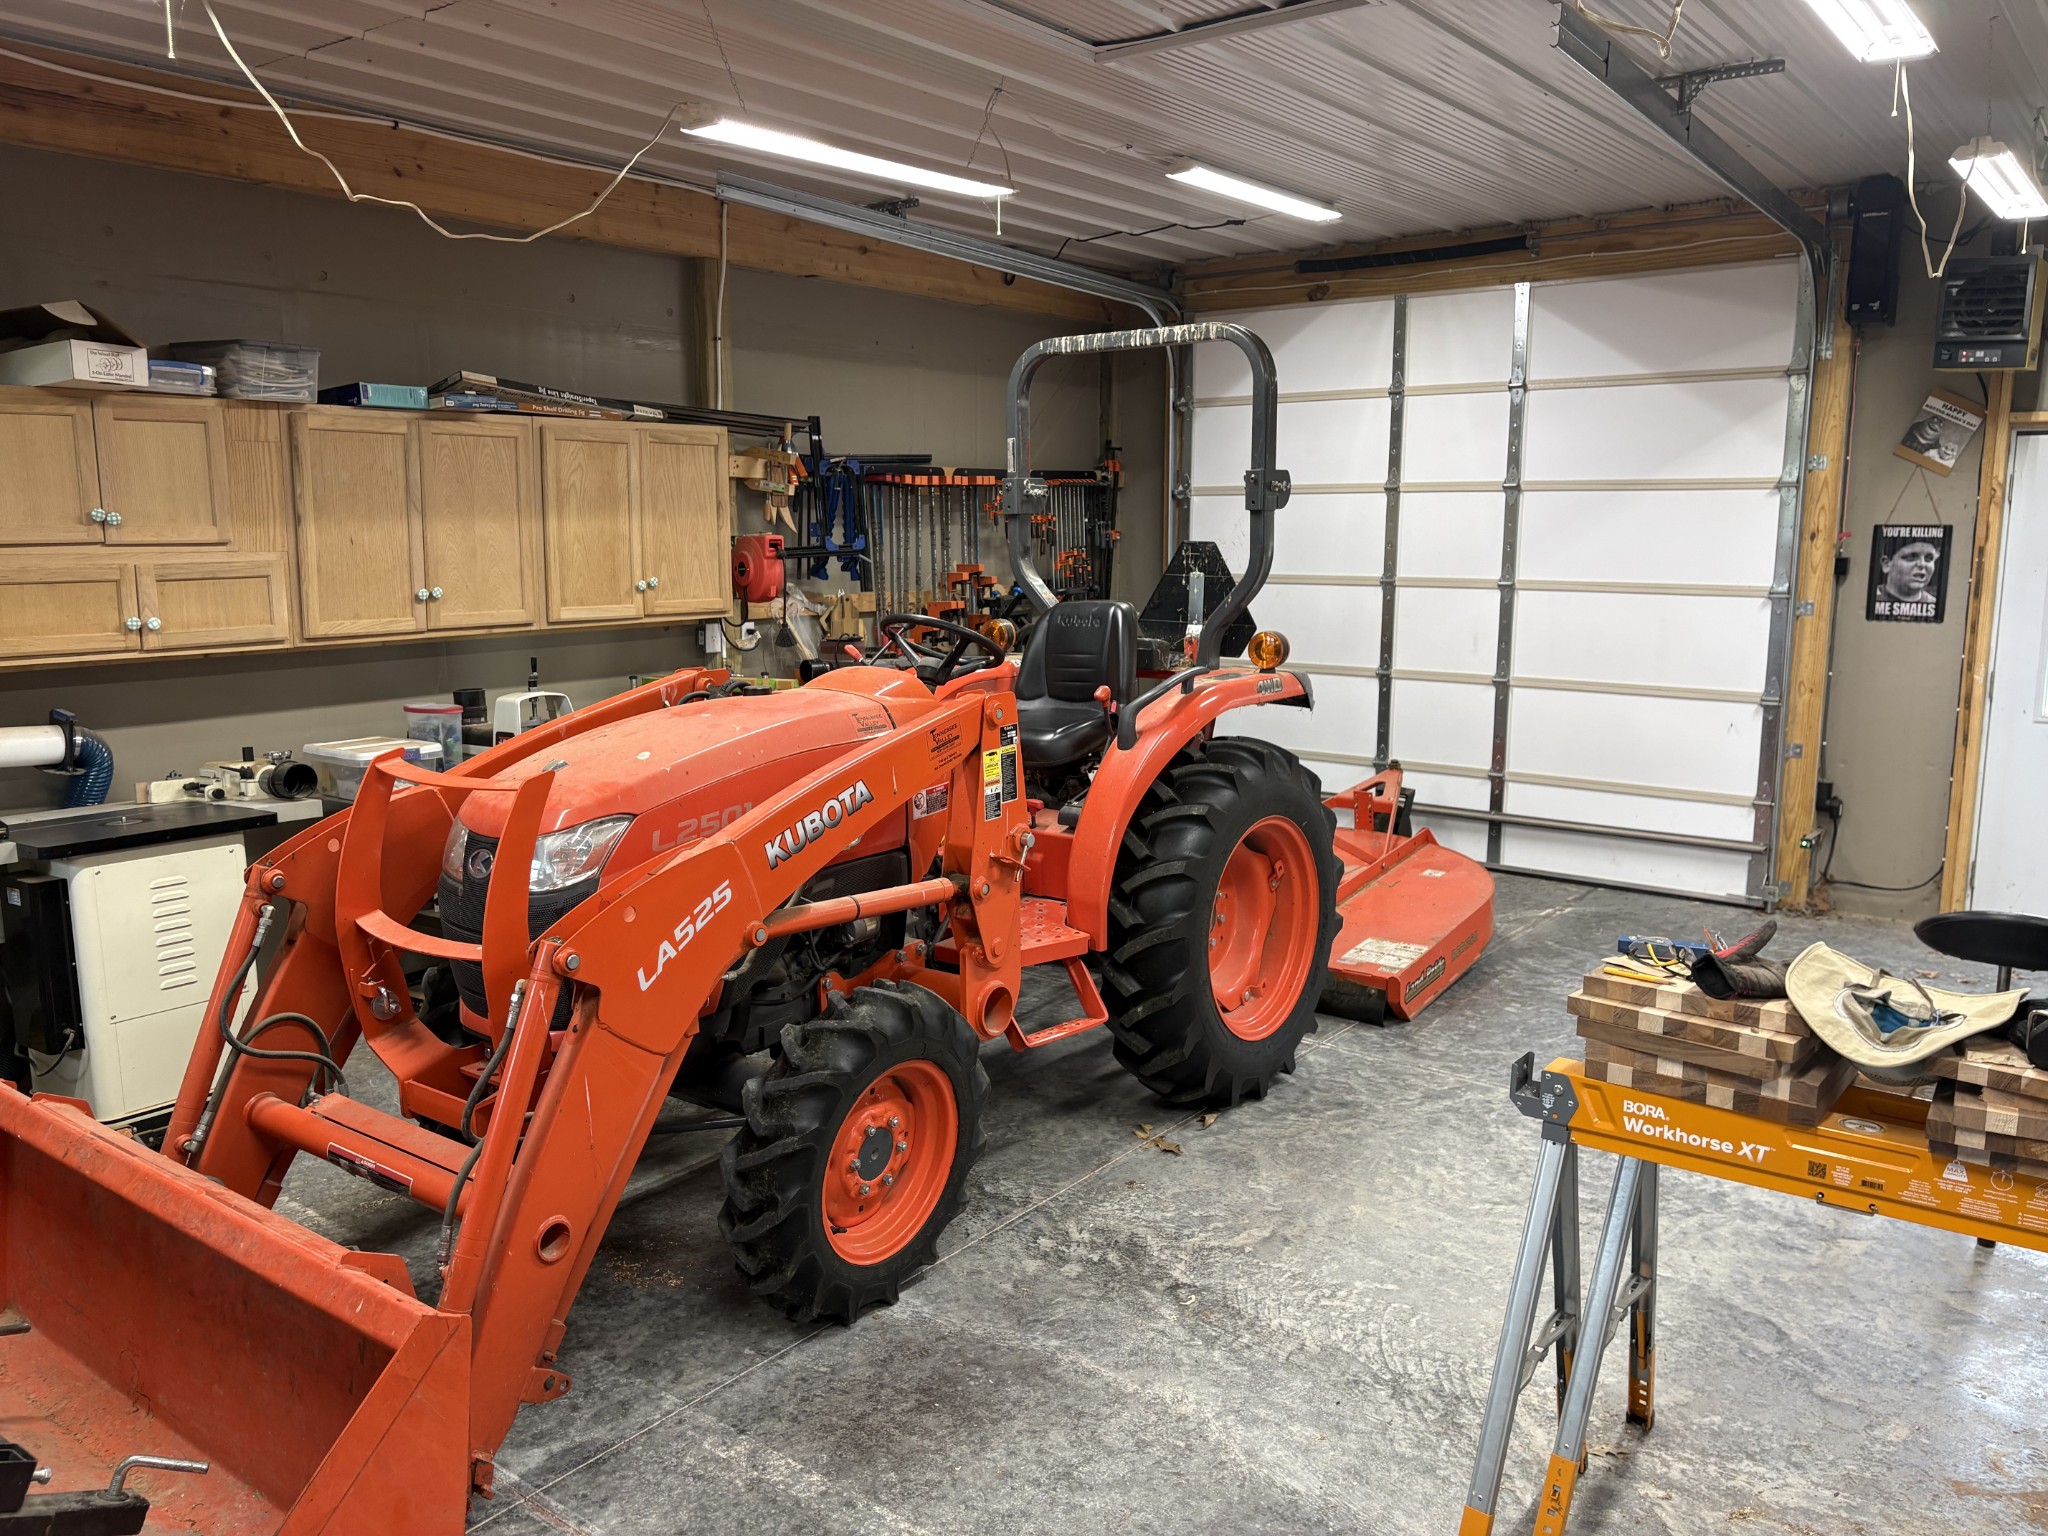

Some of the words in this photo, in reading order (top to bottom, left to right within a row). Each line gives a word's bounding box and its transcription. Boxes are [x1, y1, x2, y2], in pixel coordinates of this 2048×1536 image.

[538, 386, 547, 395] Jig
[547, 389, 560, 398] Line
[557, 407, 577, 415] Drilling
[1941, 403, 1968, 417] HAPPY
[1882, 527, 1910, 537] YOU'RE
[1912, 527, 1944, 538] KILLING
[1875, 602, 1890, 615] ME
[1892, 602, 1936, 616] SMALLS
[1257, 677, 1283, 695] 4WD
[764, 779, 874, 871] KUBOTA
[637, 879, 732, 992] LA525
[1623, 1116, 1734, 1153] Workhorse
[1737, 1141, 1770, 1163] XT
